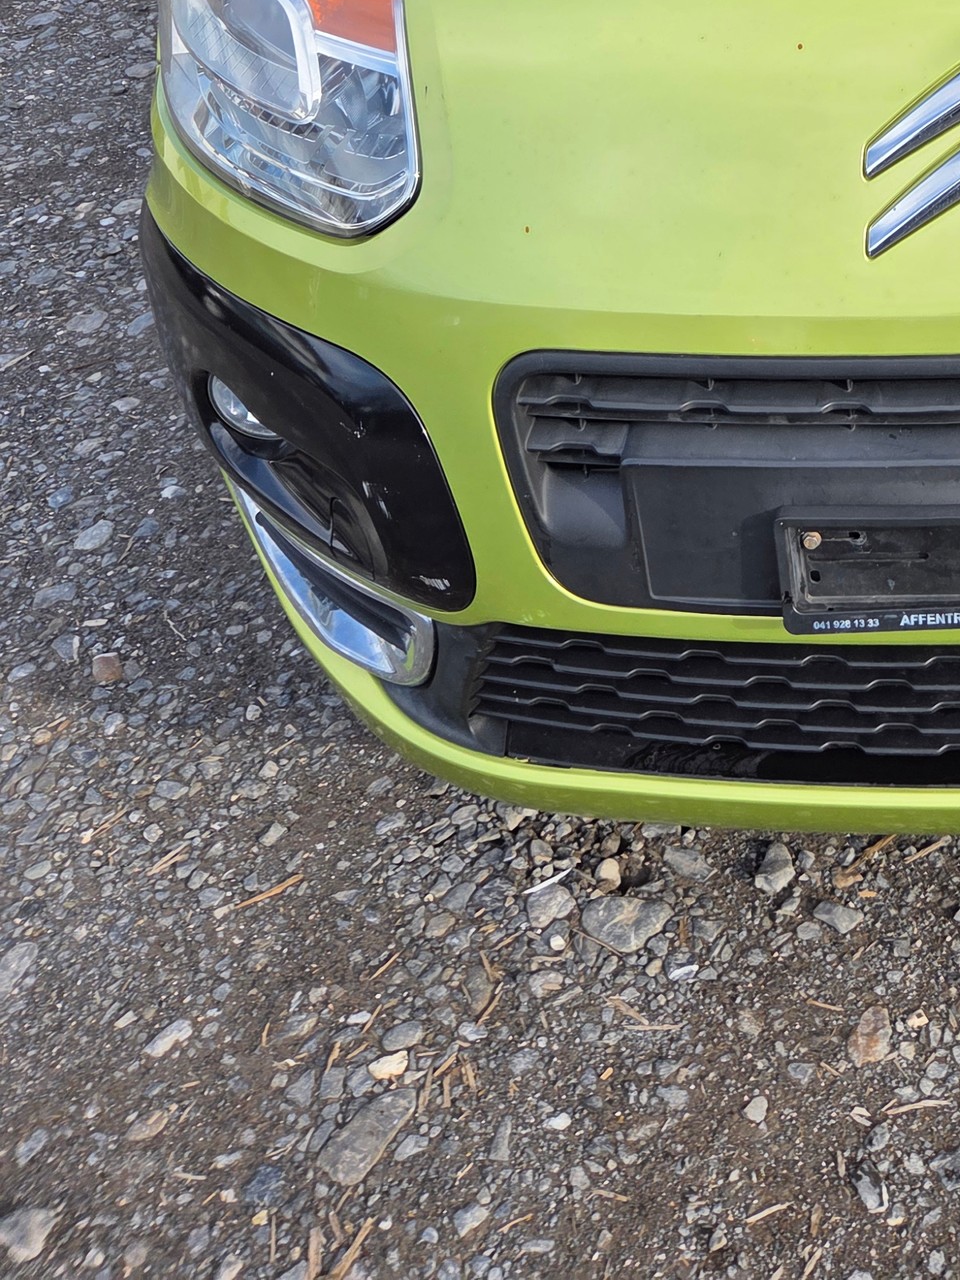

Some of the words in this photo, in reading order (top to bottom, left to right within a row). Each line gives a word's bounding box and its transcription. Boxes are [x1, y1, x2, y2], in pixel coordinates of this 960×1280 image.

[813, 621, 831, 630] 041
[833, 620, 851, 629] 928
[853, 619, 865, 628] 13
[867, 619, 880, 628] 33
